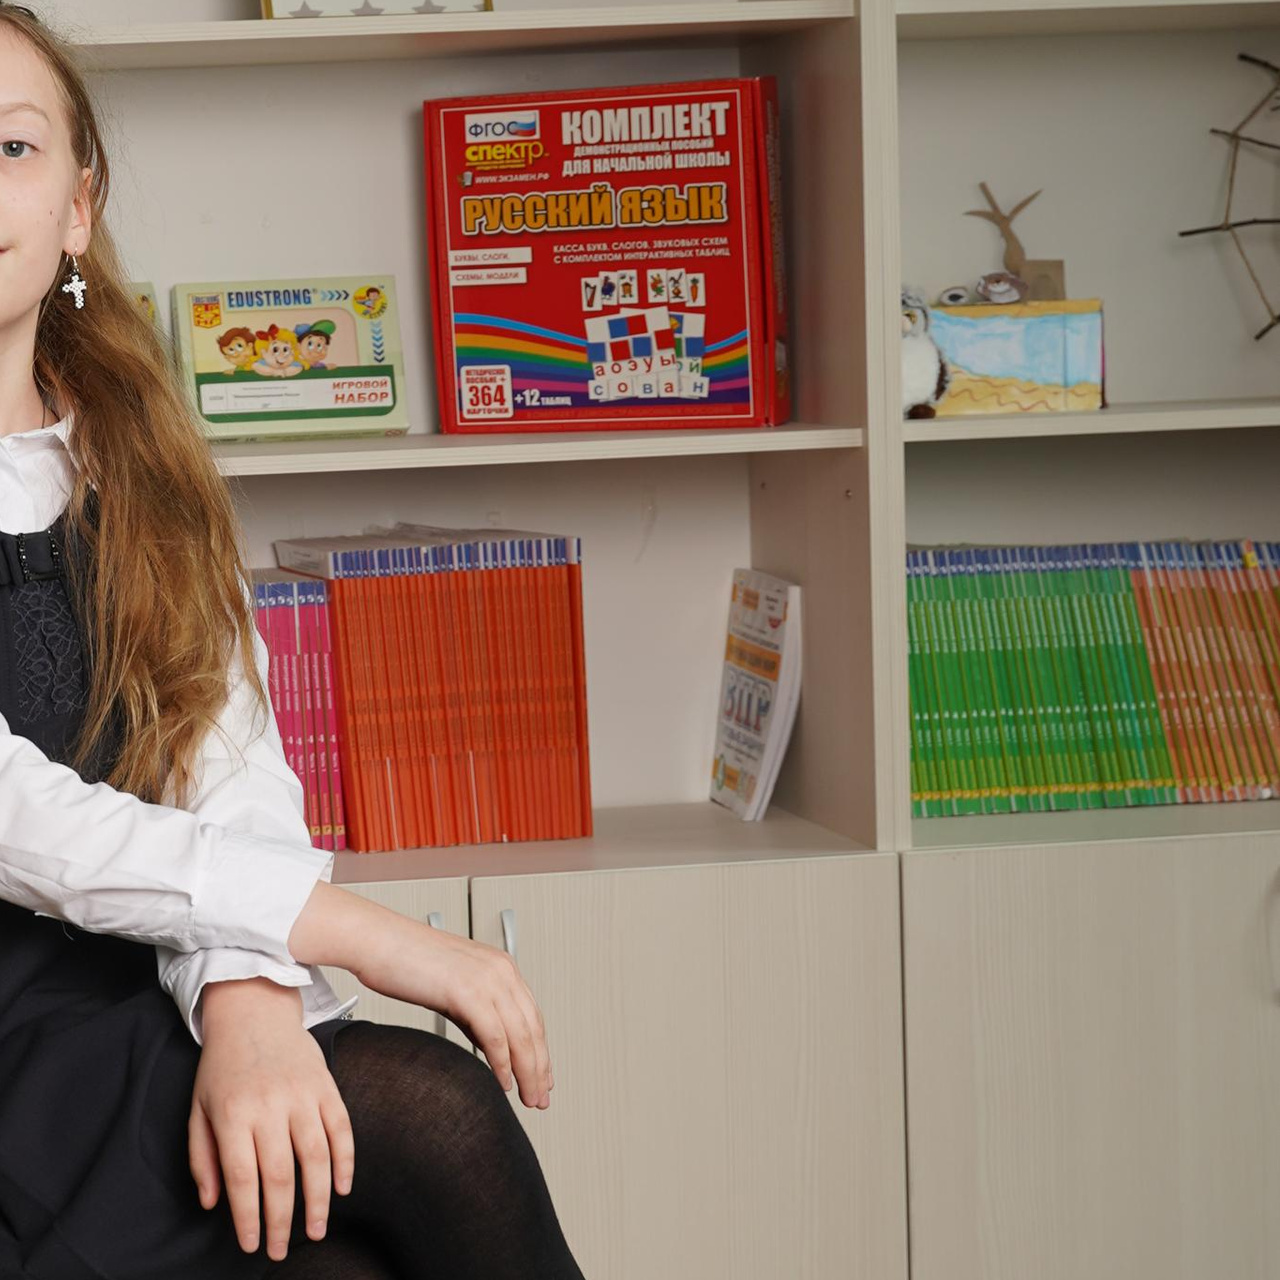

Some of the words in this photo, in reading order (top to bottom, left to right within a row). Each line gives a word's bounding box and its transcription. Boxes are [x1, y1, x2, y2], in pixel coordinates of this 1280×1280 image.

[468, 121, 518, 138] ФГОС
[561, 101, 730, 145] КОМПЛЕКТ
[562, 159, 591, 177] ДЛЯ
[593, 154, 672, 174] НАЧАЛЬНОЙ
[674, 151, 731, 169] ШКОЛЫ
[462, 183, 613, 233] РУССКИЙ
[619, 184, 724, 225] ЯЗЫК
[553, 244, 585, 254] КАССА
[653, 239, 700, 249] ЗВУКОВЫХ
[702, 236, 728, 246] СХЕМ
[553, 256, 561, 264] С
[562, 253, 622, 264] КОМПЛЕКТОМ
[623, 250, 694, 261] ИНТЕРАКТИВНЫХ
[695, 248, 731, 258] ТАБЛИЦ
[486, 271, 519, 280] МОДЕЛИ
[595, 365, 605, 376] а
[611, 363, 622, 374] о
[643, 358, 653, 373] у
[660, 354, 676, 366] ы
[332, 380, 389, 390] ИГРОВОЙ
[643, 384, 653, 394] в
[664, 382, 674, 393] а
[693, 382, 703, 393] н
[334, 391, 389, 404] НАБОР
[469, 385, 505, 406] 364
[466, 407, 510, 416] КАРТОЧКИ
